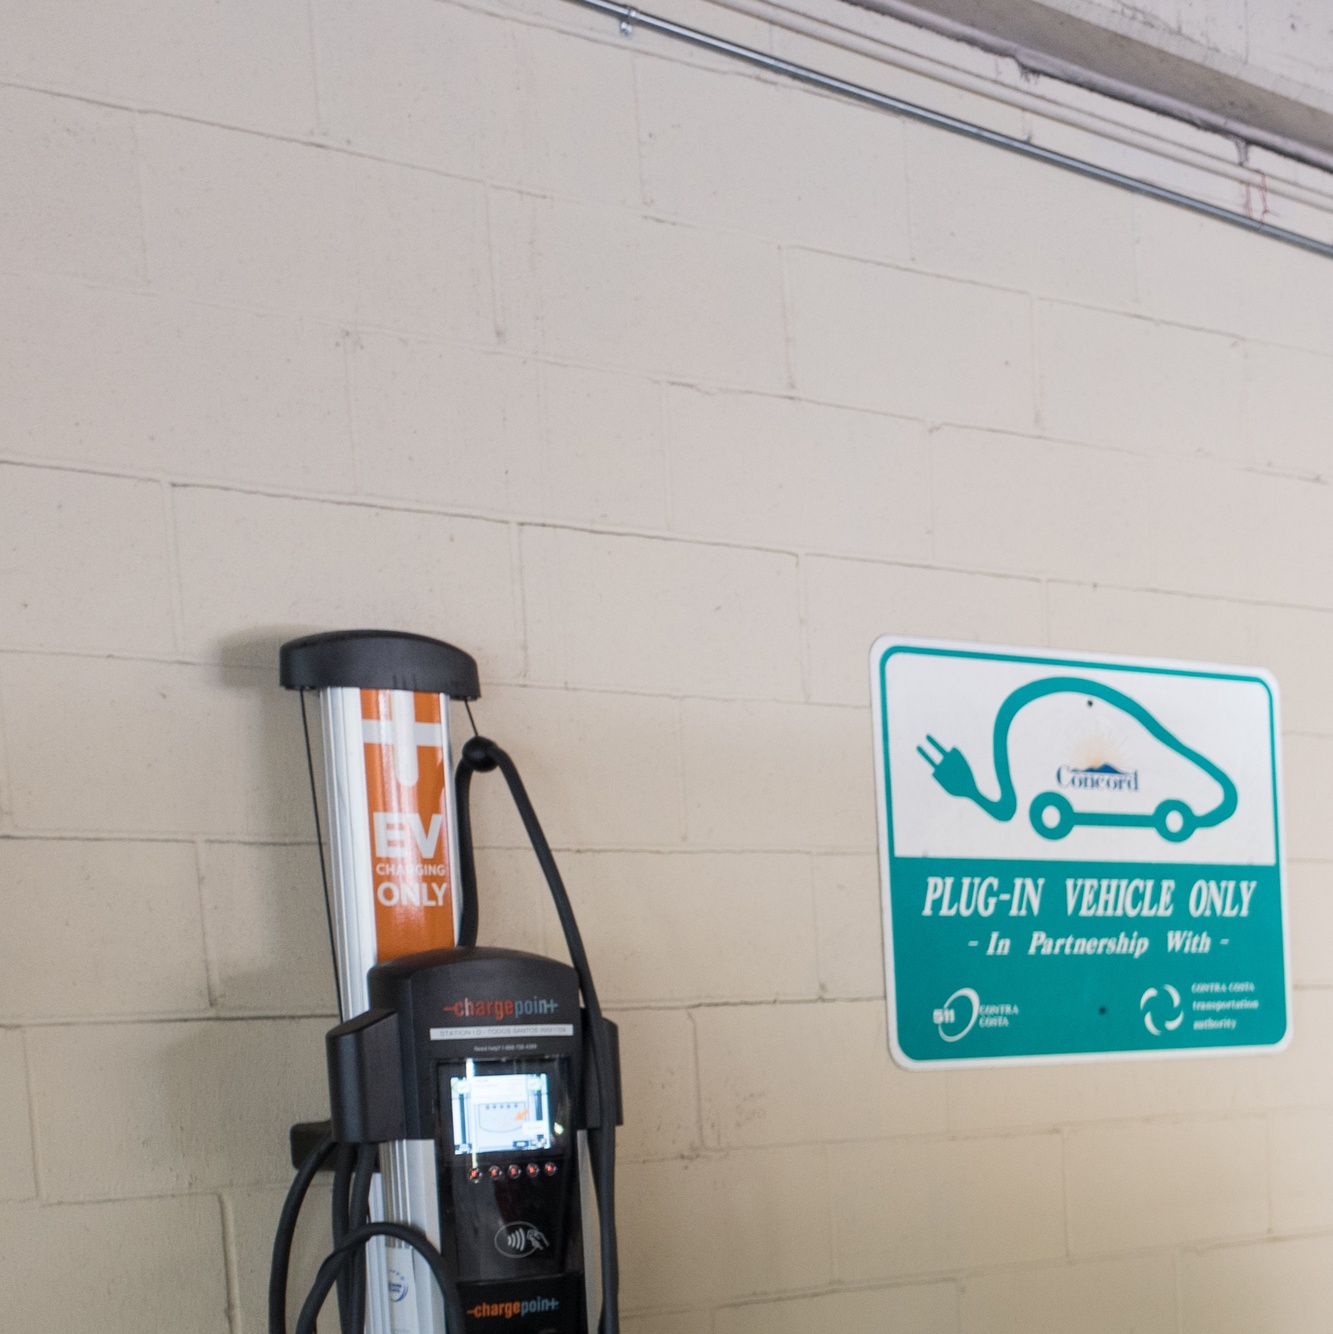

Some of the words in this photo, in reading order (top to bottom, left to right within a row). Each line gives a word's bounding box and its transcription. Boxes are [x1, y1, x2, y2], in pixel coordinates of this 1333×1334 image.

[1056, 764, 1139, 792] Concord
[373, 812, 444, 860] EV
[376, 863, 446, 876] CHARGING
[377, 881, 448, 907] ONLY
[922, 876, 1045, 917] PLUG-IN
[1065, 877, 1175, 917] VEHICLE
[1188, 879, 1257, 917] ONLY
[986, 931, 1010, 955] In
[1028, 931, 1149, 959] Partnership
[1166, 931, 1211, 953] With
[1192, 998, 1259, 1012] transportation
[1193, 1017, 1237, 1030] authority
